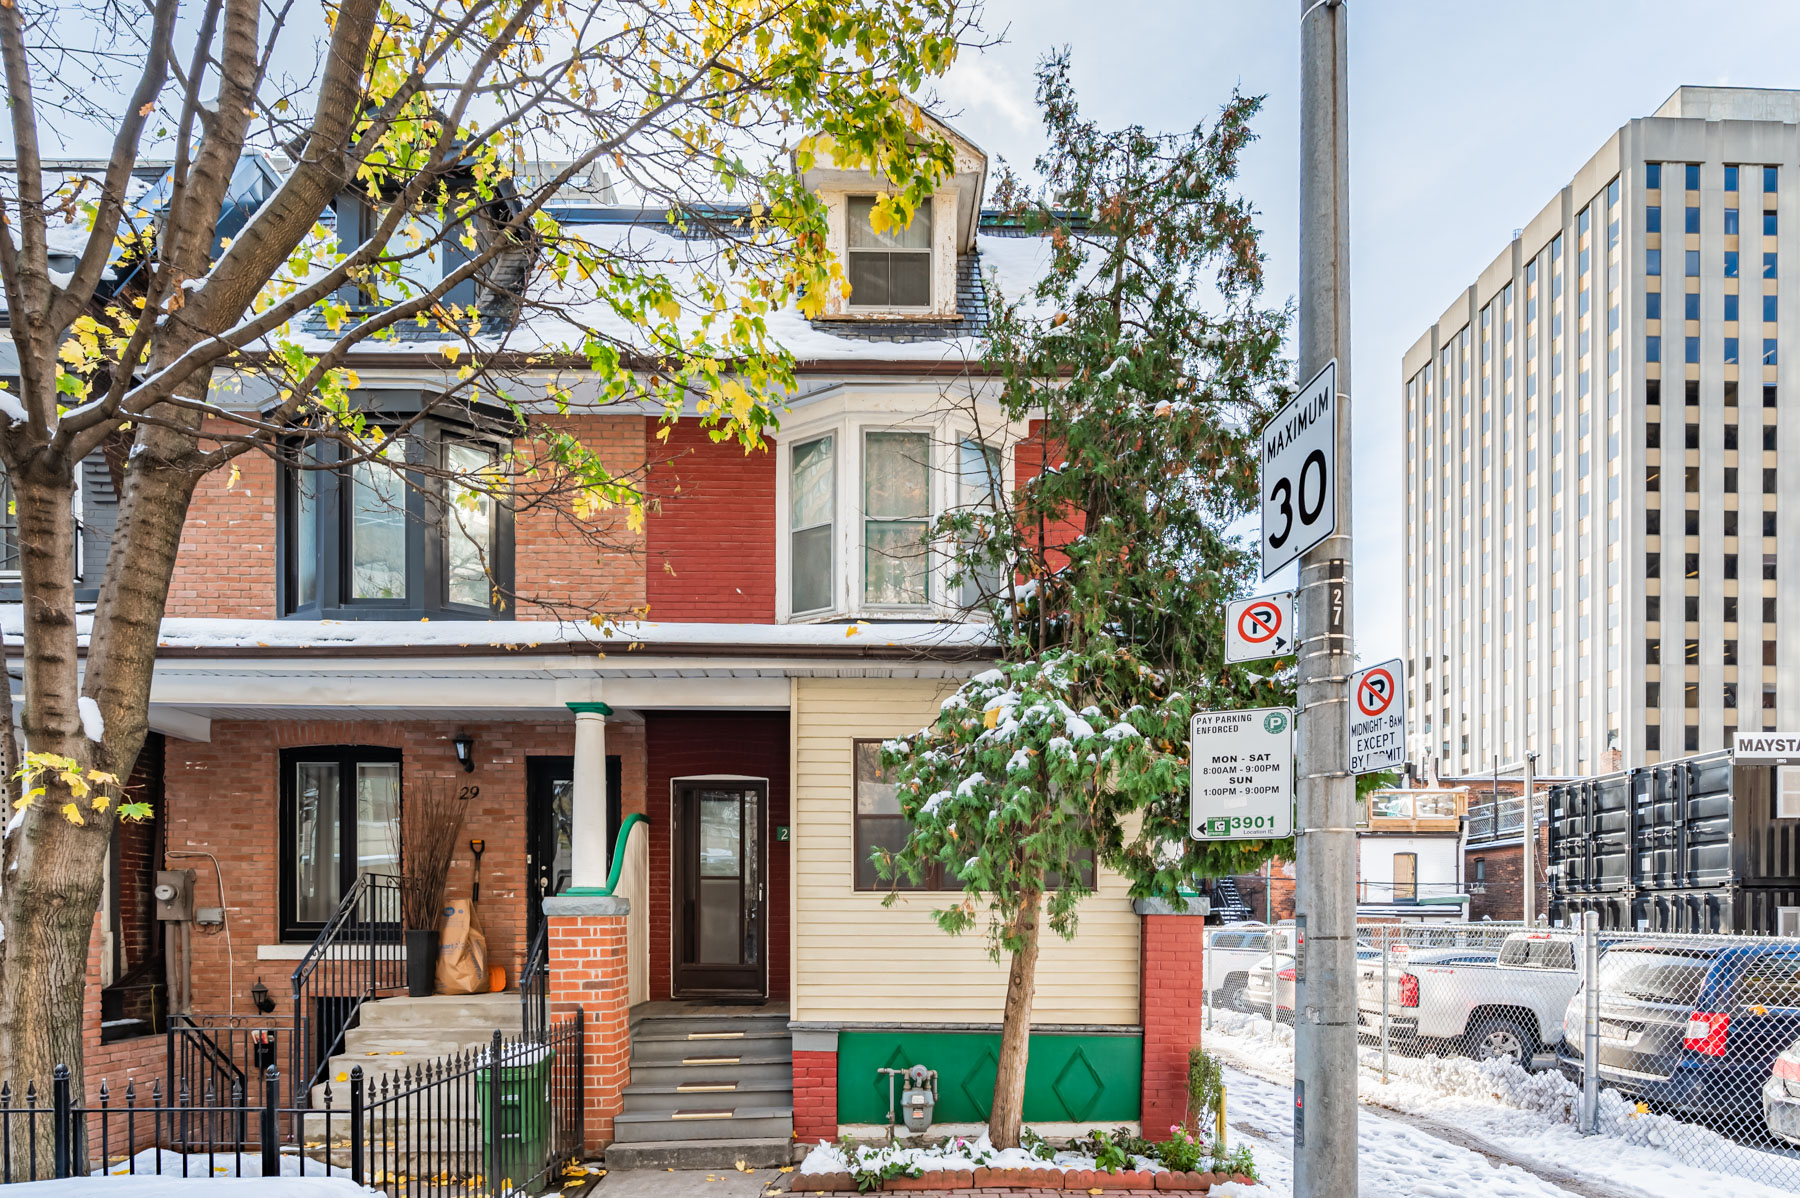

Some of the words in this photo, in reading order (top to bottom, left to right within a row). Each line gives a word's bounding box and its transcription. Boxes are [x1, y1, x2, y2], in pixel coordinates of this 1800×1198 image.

[1267, 386, 1329, 464] MAXIMUM
[1269, 449, 1327, 549] 30
[1333, 589, 1342, 625] 27
[1196, 716, 1213, 725] PAY
[1215, 714, 1252, 724] PARKING
[1270, 717, 1282, 729] P
[1351, 717, 1383, 738] MIDNIGHT
[1389, 714, 1403, 728] 8AM
[1196, 724, 1239, 735] ENFORCED
[1357, 731, 1395, 752] EXCEPT
[1212, 755, 1238, 764] MON
[1249, 753, 1271, 762] SAT
[1352, 754, 1364, 769] BY
[1366, 746, 1402, 767] MIT
[1203, 766, 1237, 775] 8:00AM
[1245, 764, 1280, 773] 9:00PM
[1229, 776, 1253, 784] SUN
[459, 785, 480, 800] 29
[1204, 788, 1237, 796] 1:00PM
[1245, 786, 1280, 795] 9:00PM
[1231, 815, 1275, 829] 3901
[781, 828, 789, 840] 2
